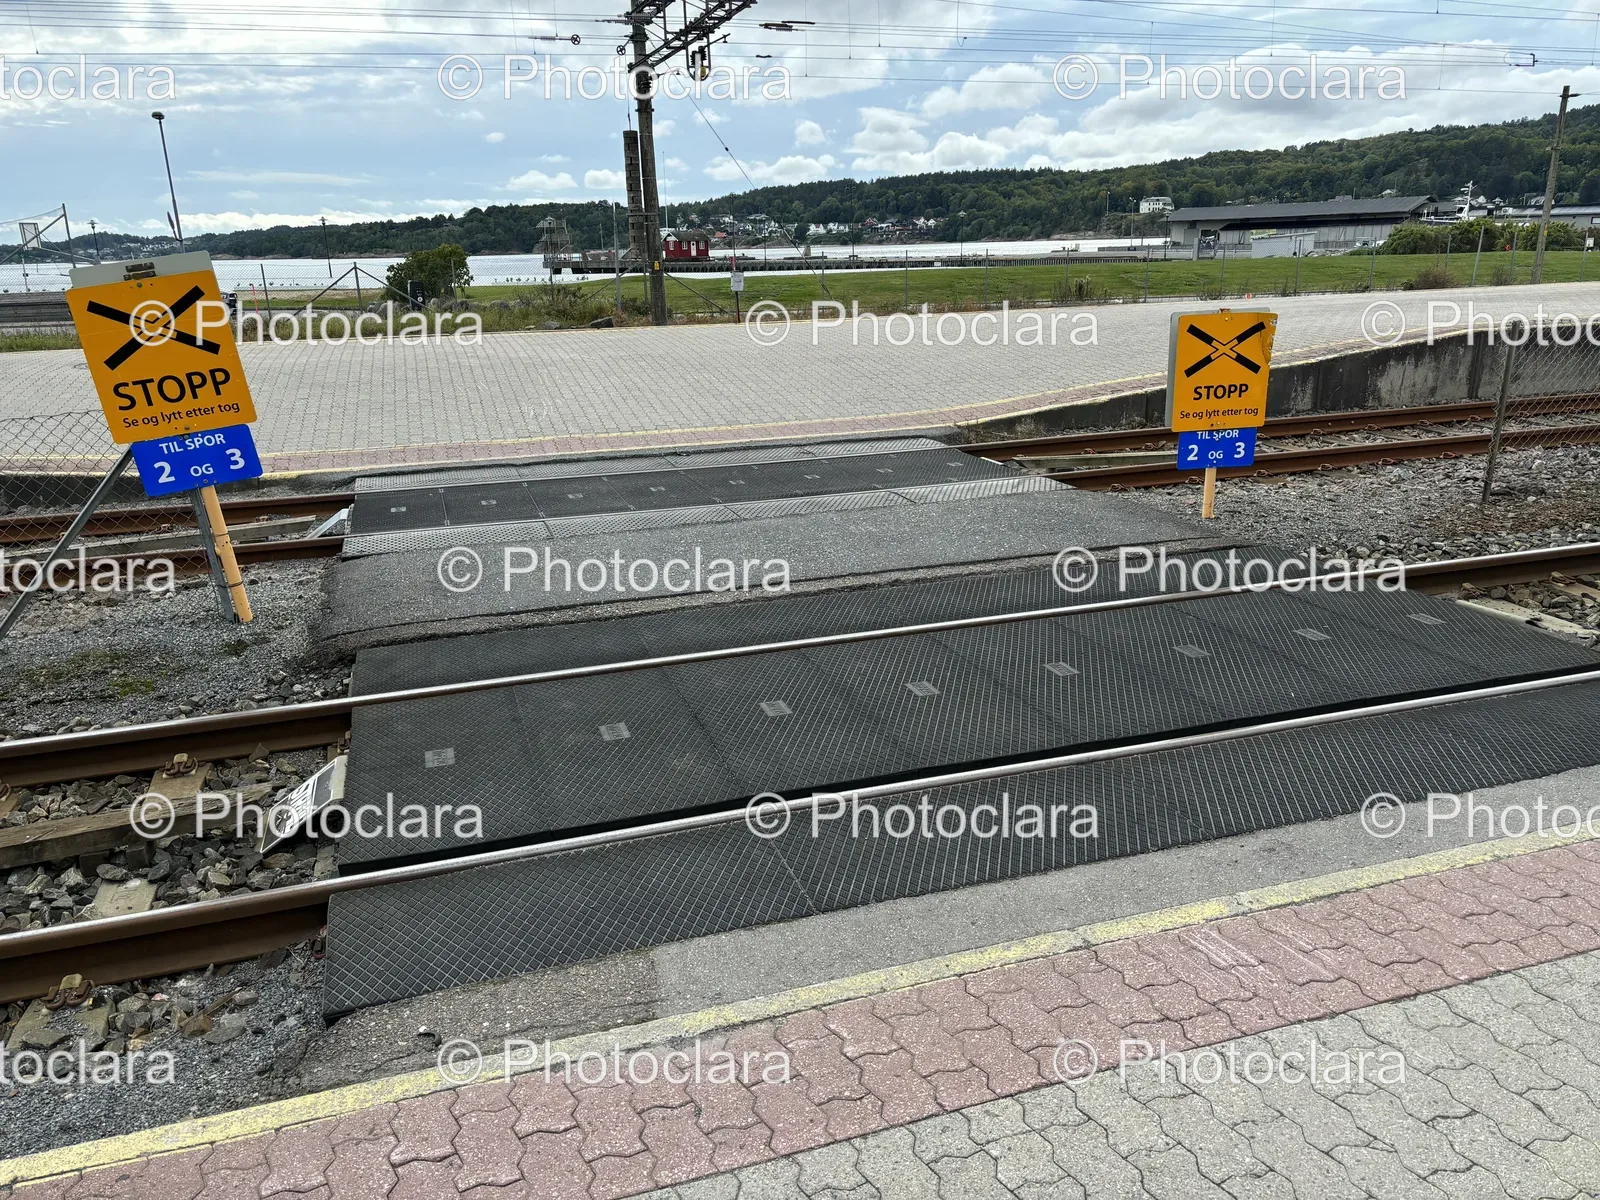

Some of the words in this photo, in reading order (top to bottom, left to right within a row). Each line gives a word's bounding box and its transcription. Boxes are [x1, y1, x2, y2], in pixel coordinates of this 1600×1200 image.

[113, 367, 231, 411] STOPP
[1193, 383, 1249, 401] STOPP
[123, 417, 139, 428] Se
[142, 415, 159, 426] og
[160, 411, 184, 424] lytt
[186, 405, 216, 418] etter
[218, 402, 240, 413] tog
[1180, 410, 1191, 419] Se
[1192, 410, 1204, 420] og
[1205, 408, 1220, 418] lytt
[1221, 407, 1243, 417] etter
[1244, 407, 1259, 416] tog
[159, 441, 184, 454] TIL
[185, 433, 226, 450] SPOR
[1197, 431, 1211, 439] TIL
[1213, 429, 1239, 439] SPOR
[1187, 444, 1199, 461] 2
[1208, 450, 1223, 460] OG
[1233, 442, 1245, 459] 3
[153, 461, 176, 484] 2
[190, 463, 214, 477] OG
[225, 448, 246, 470] 3
